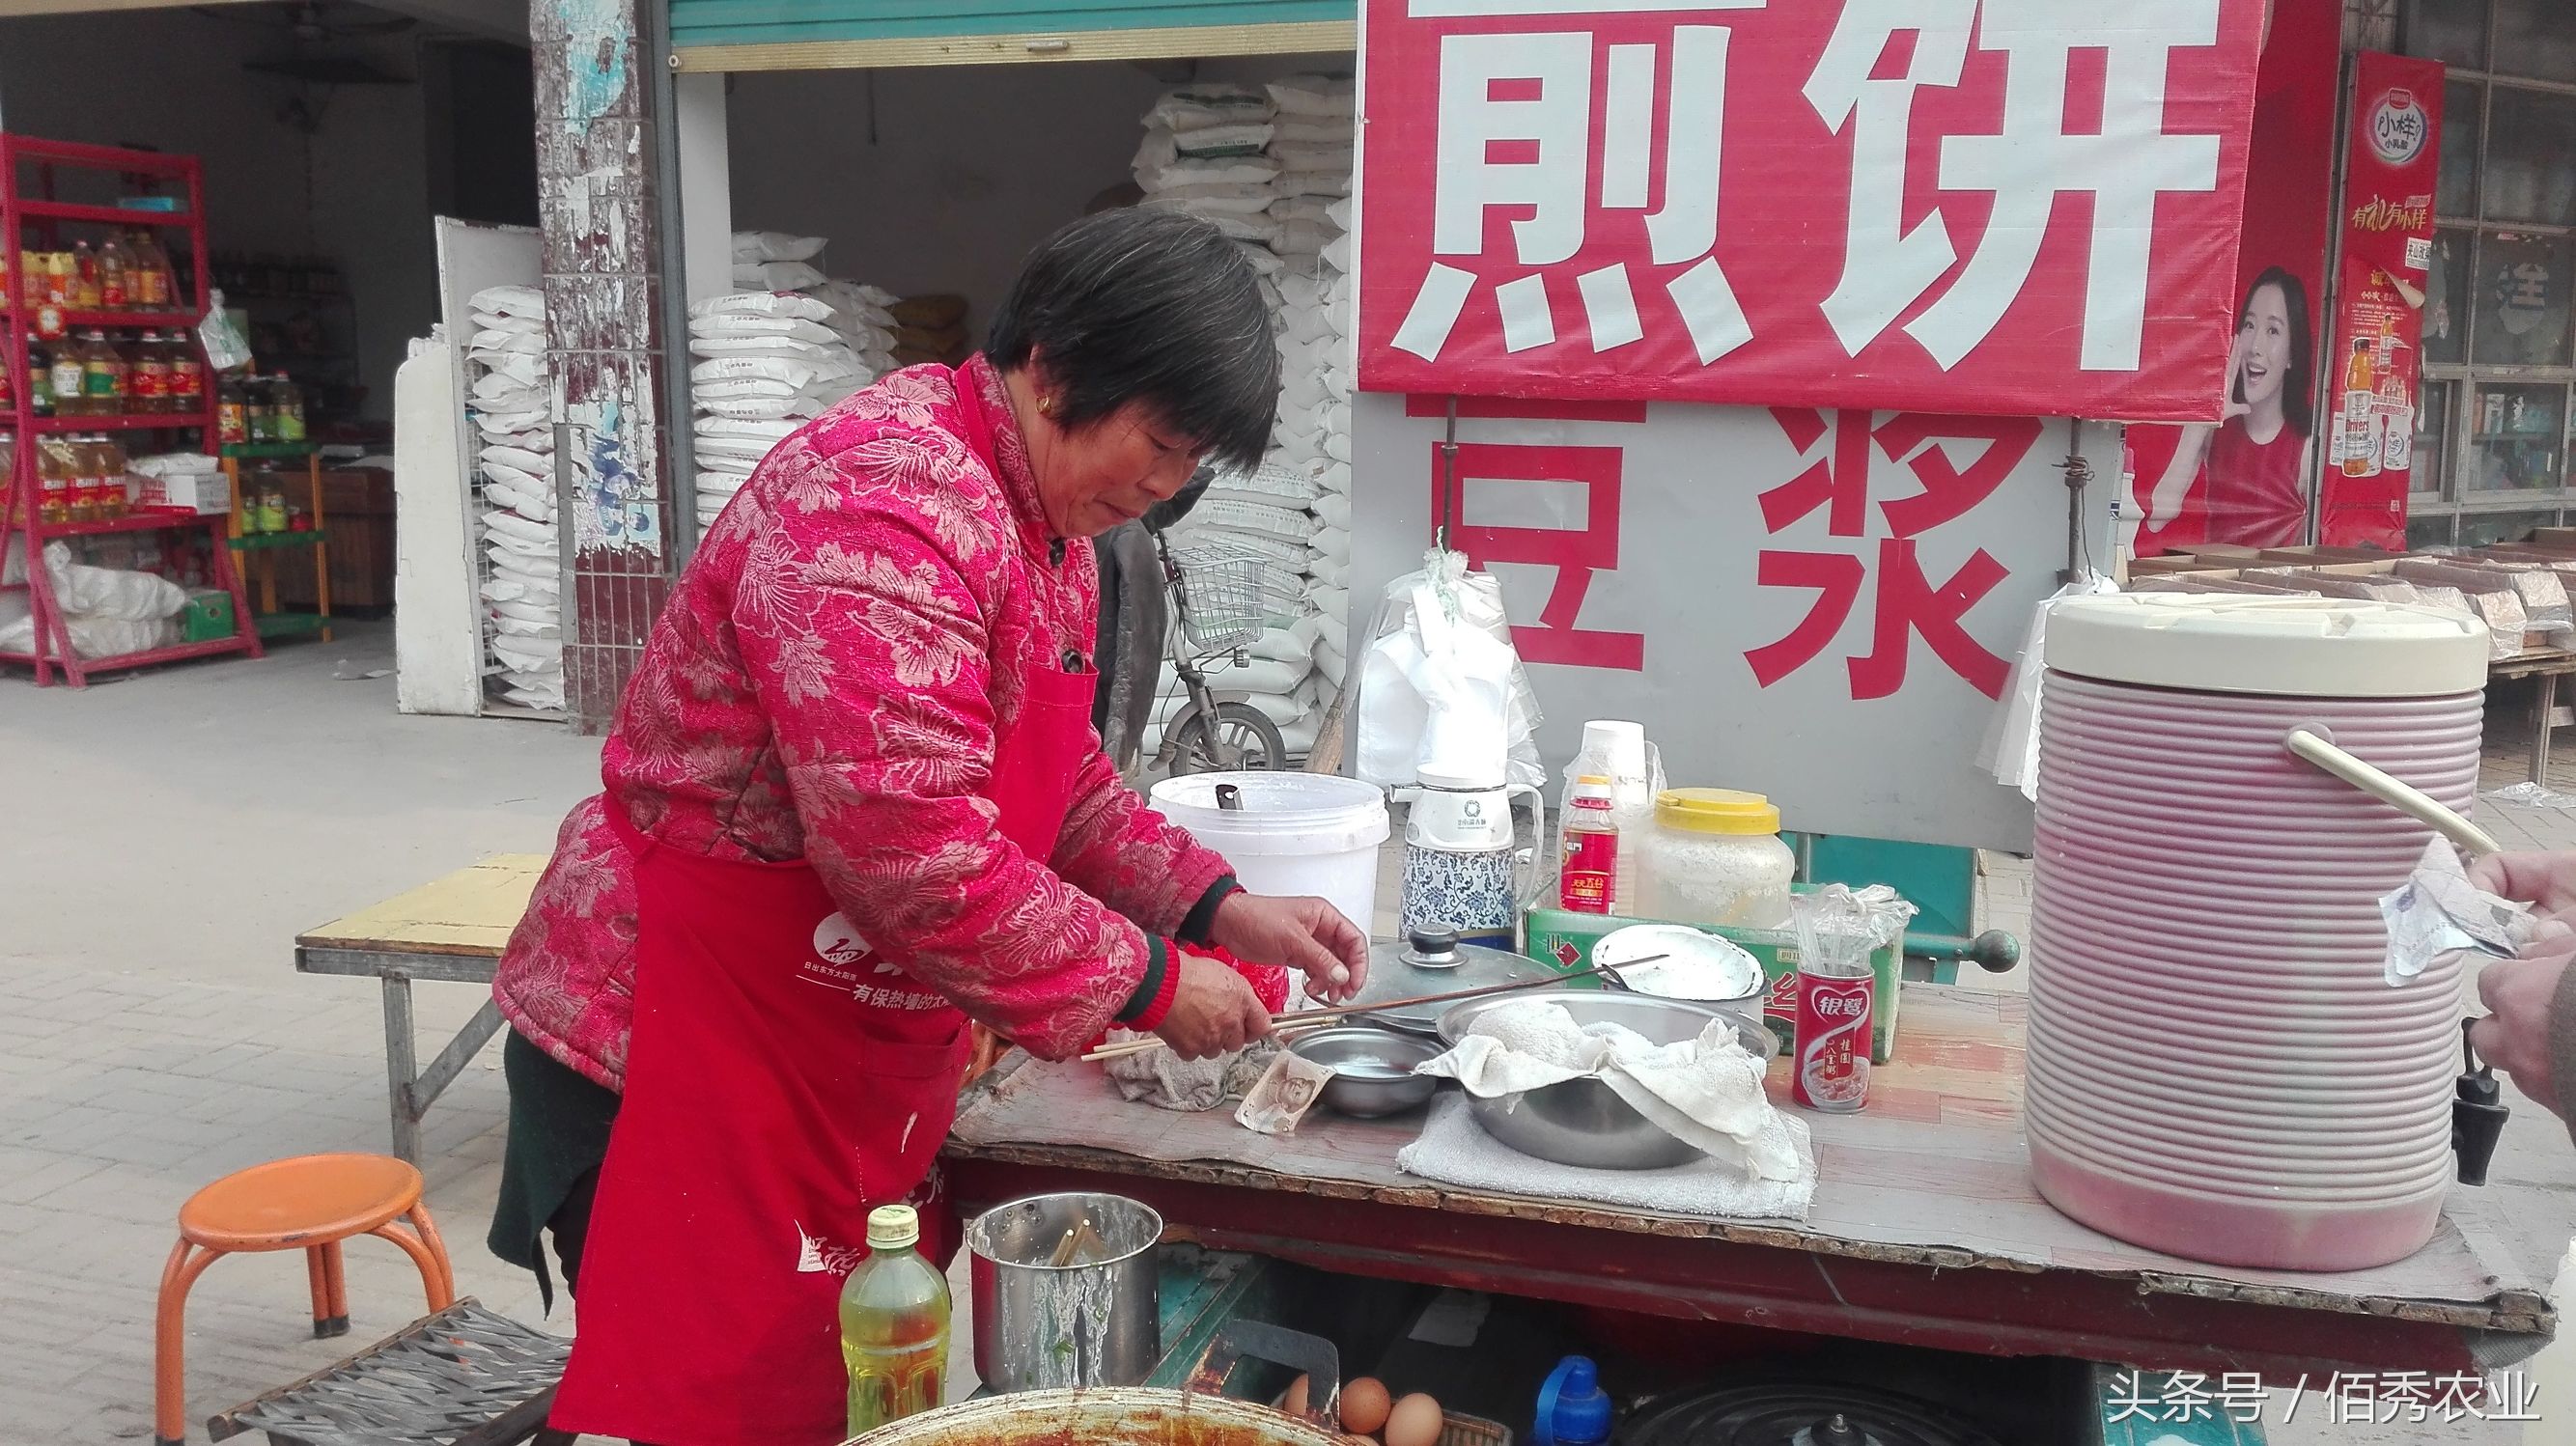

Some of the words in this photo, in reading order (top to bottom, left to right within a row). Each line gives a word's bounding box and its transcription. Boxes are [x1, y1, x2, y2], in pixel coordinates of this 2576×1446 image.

[1389, 0, 2220, 373] 煎饼
[1406, 394, 2044, 702] 豆浆
[1571, 877, 1604, 888] 天天五谷
[1819, 996, 1863, 1016] 银鹭
[1825, 1047, 1837, 1075] 八宝粥
